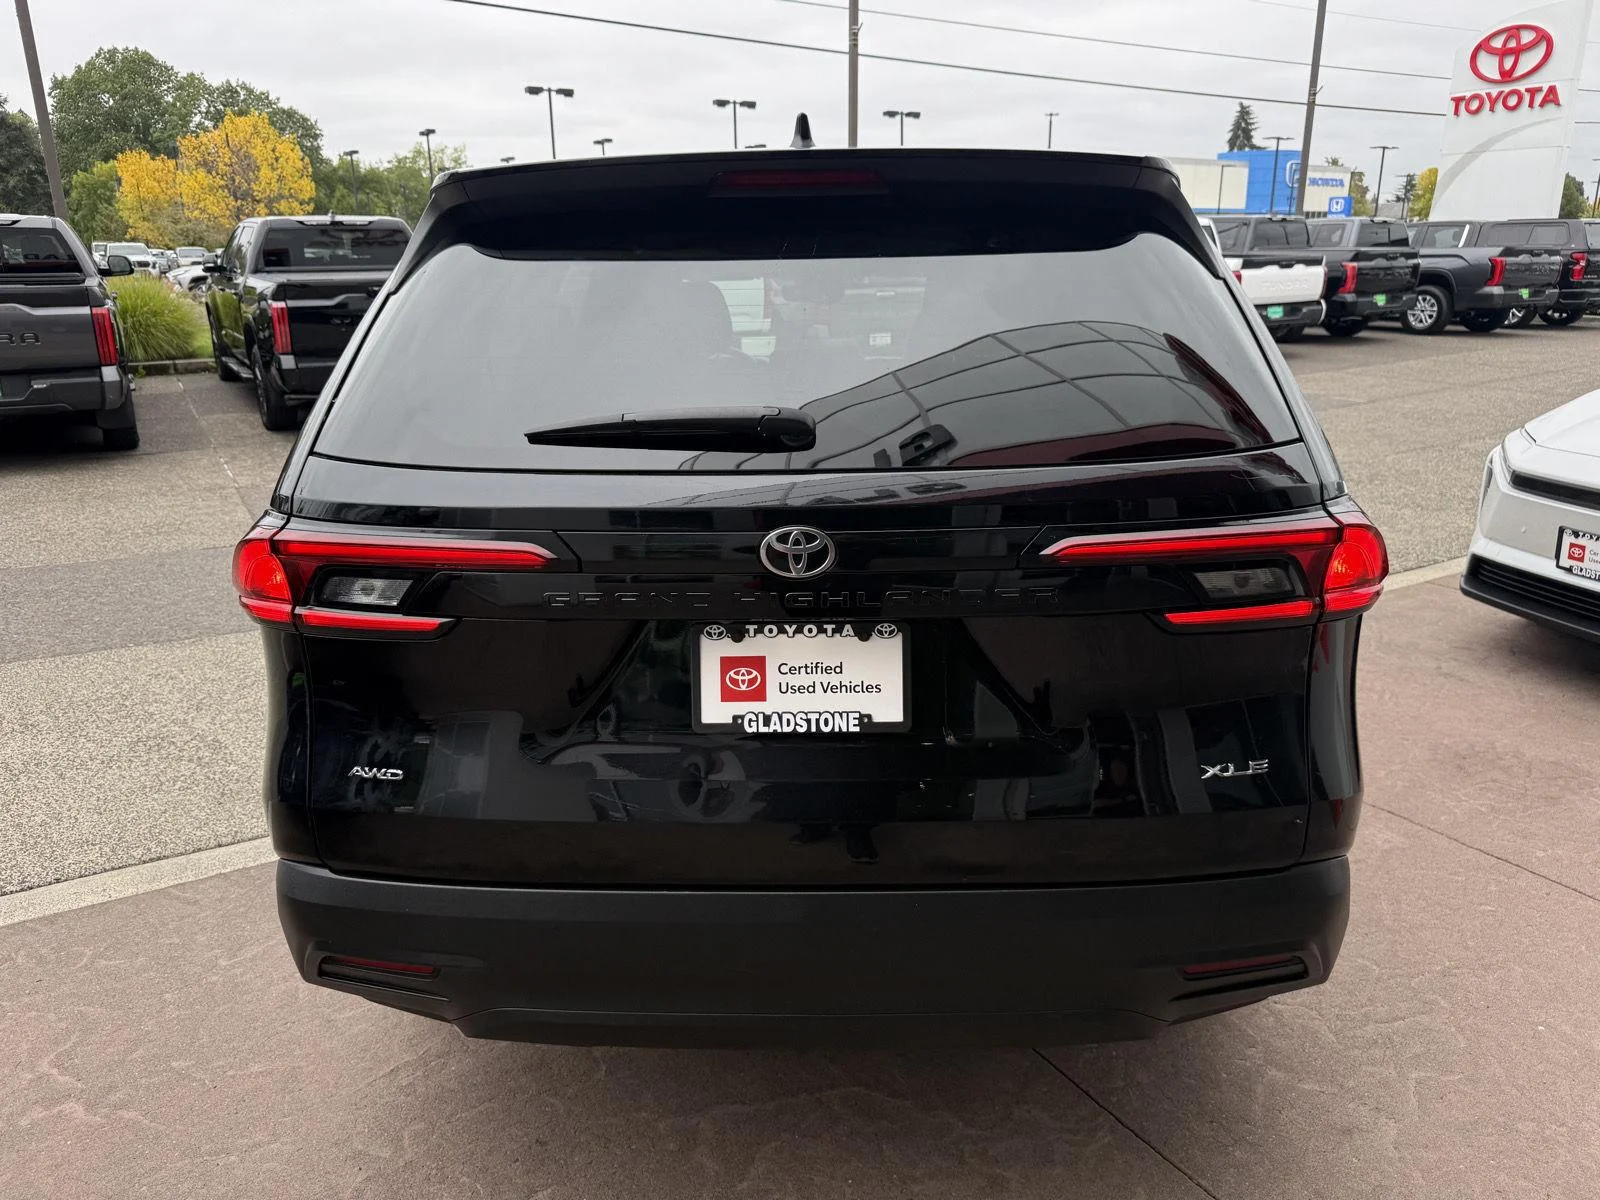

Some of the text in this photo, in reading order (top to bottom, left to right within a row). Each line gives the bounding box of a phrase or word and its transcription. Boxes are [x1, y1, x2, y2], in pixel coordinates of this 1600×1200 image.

[1450, 84, 1561, 117] TOYOTA
[733, 587, 1058, 608] HIGHLANDER
[745, 623, 856, 638] TOYOTA
[777, 661, 843, 675] Certified
[778, 680, 882, 694] Used Vehicles
[743, 711, 861, 733] GLADSTONE
[348, 765, 404, 780] AWD
[1200, 759, 1269, 779] XLE
